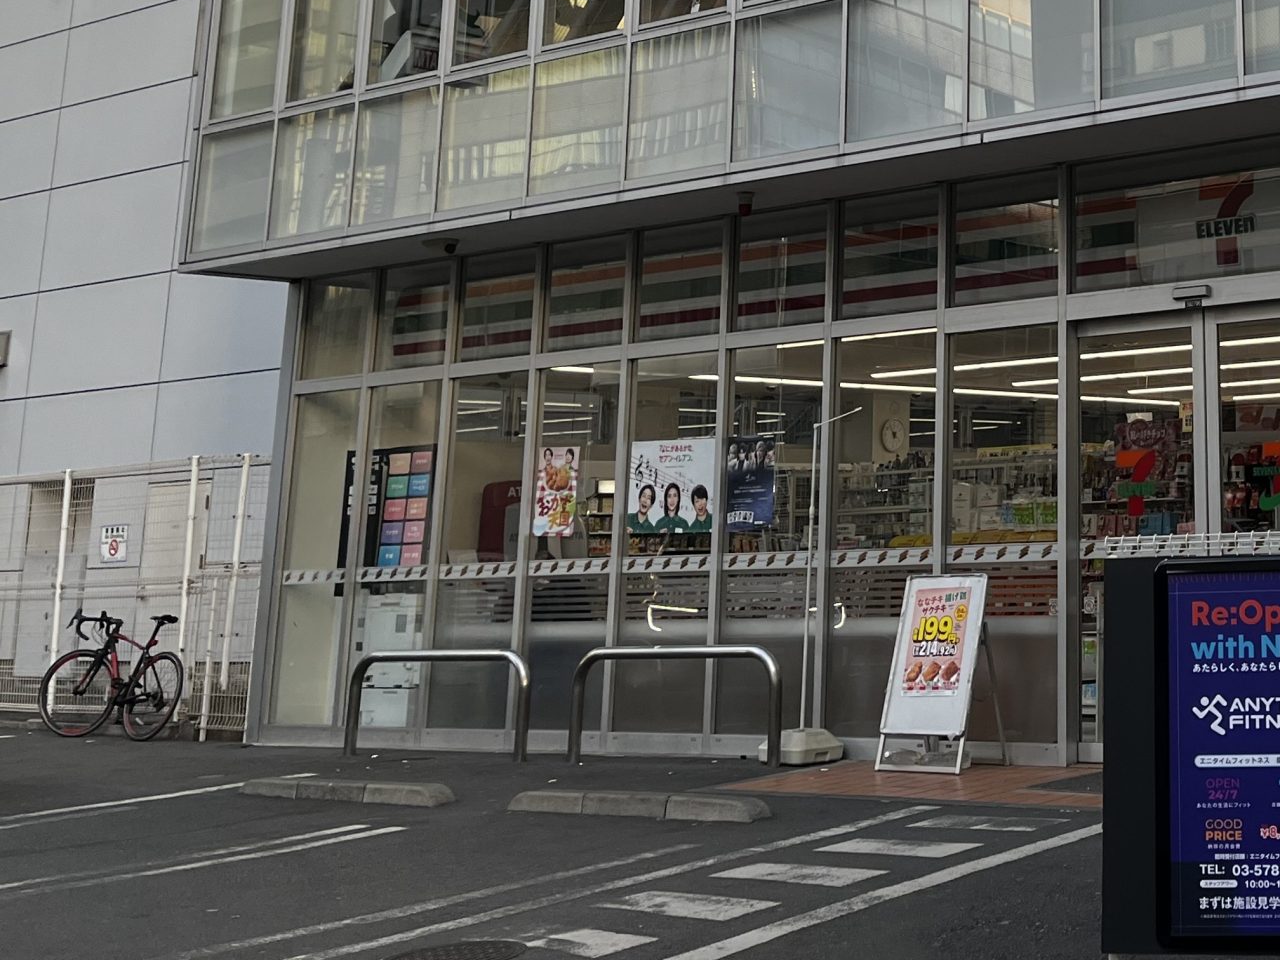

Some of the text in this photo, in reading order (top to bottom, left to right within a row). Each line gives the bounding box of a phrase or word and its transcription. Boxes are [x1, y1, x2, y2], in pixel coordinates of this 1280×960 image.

[507, 486, 522, 497] AT
[1191, 634, 1255, 660] with
[1199, 756, 1270, 766] エニタイムフィットネス
[1206, 777, 1240, 789] OPEN
[1208, 789, 1239, 800] 24/7
[1205, 818, 1243, 830] GOOD
[1205, 830, 1243, 841] PRICE
[1199, 863, 1226, 875] TEL:
